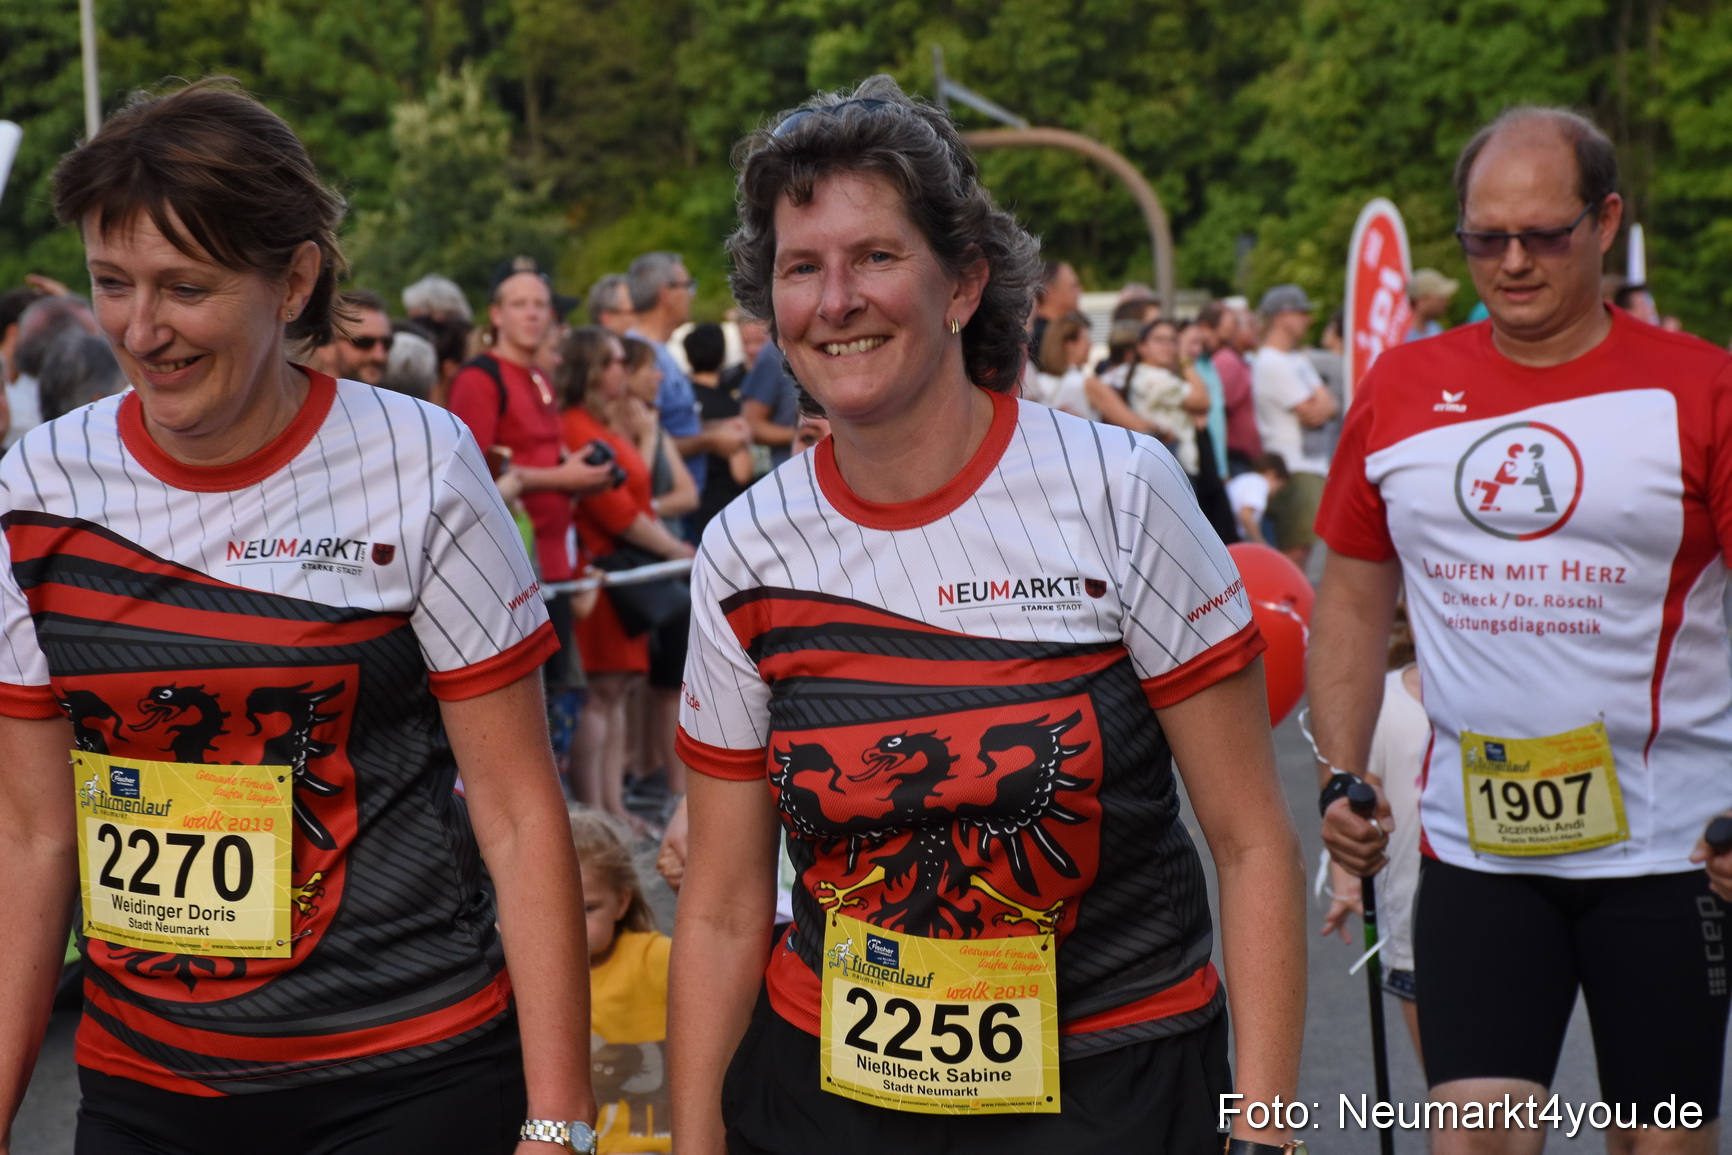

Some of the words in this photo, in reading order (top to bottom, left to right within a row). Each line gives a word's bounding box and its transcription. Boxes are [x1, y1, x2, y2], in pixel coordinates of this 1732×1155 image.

[226, 537, 368, 561] NEUMARKT
[301, 562, 334, 572] STARKE
[336, 566, 363, 576] STADT
[1422, 558, 1495, 580] LAUFEN
[1506, 564, 1549, 581] MIT
[1561, 560, 1627, 584] HERZ
[938, 576, 1079, 606] NEUMARKT
[1462, 592, 1498, 607] Heck
[1515, 594, 1539, 608] Dr.
[1544, 591, 1604, 609] Röschl
[1021, 604, 1054, 612] STARKE
[1056, 603, 1083, 611] STADT
[98, 793, 173, 818] firmenlauf
[1479, 772, 1593, 822] 1907
[182, 810, 224, 832] walk
[227, 817, 275, 832] 2019
[1555, 818, 1585, 832] Andi
[97, 823, 254, 903] 2270
[111, 893, 183, 921] Weidinger
[187, 904, 237, 922] Doris
[127, 917, 153, 932] Stadt
[155, 921, 210, 937] Neumarkt
[959, 944, 1002, 960] Gesunde
[1004, 948, 1040, 961] Firmen
[852, 955, 935, 989] firmenlauf
[978, 957, 1010, 973] laufen
[851, 973, 885, 988] neumarkt
[946, 981, 990, 1001] walk
[993, 983, 1040, 1001] 2019
[844, 986, 1024, 1065] 2256
[856, 1054, 941, 1083] Nießlbeck
[945, 1066, 1013, 1084] Sabine
[883, 1079, 914, 1095] Stadt
[916, 1084, 979, 1098] Neumarkt
